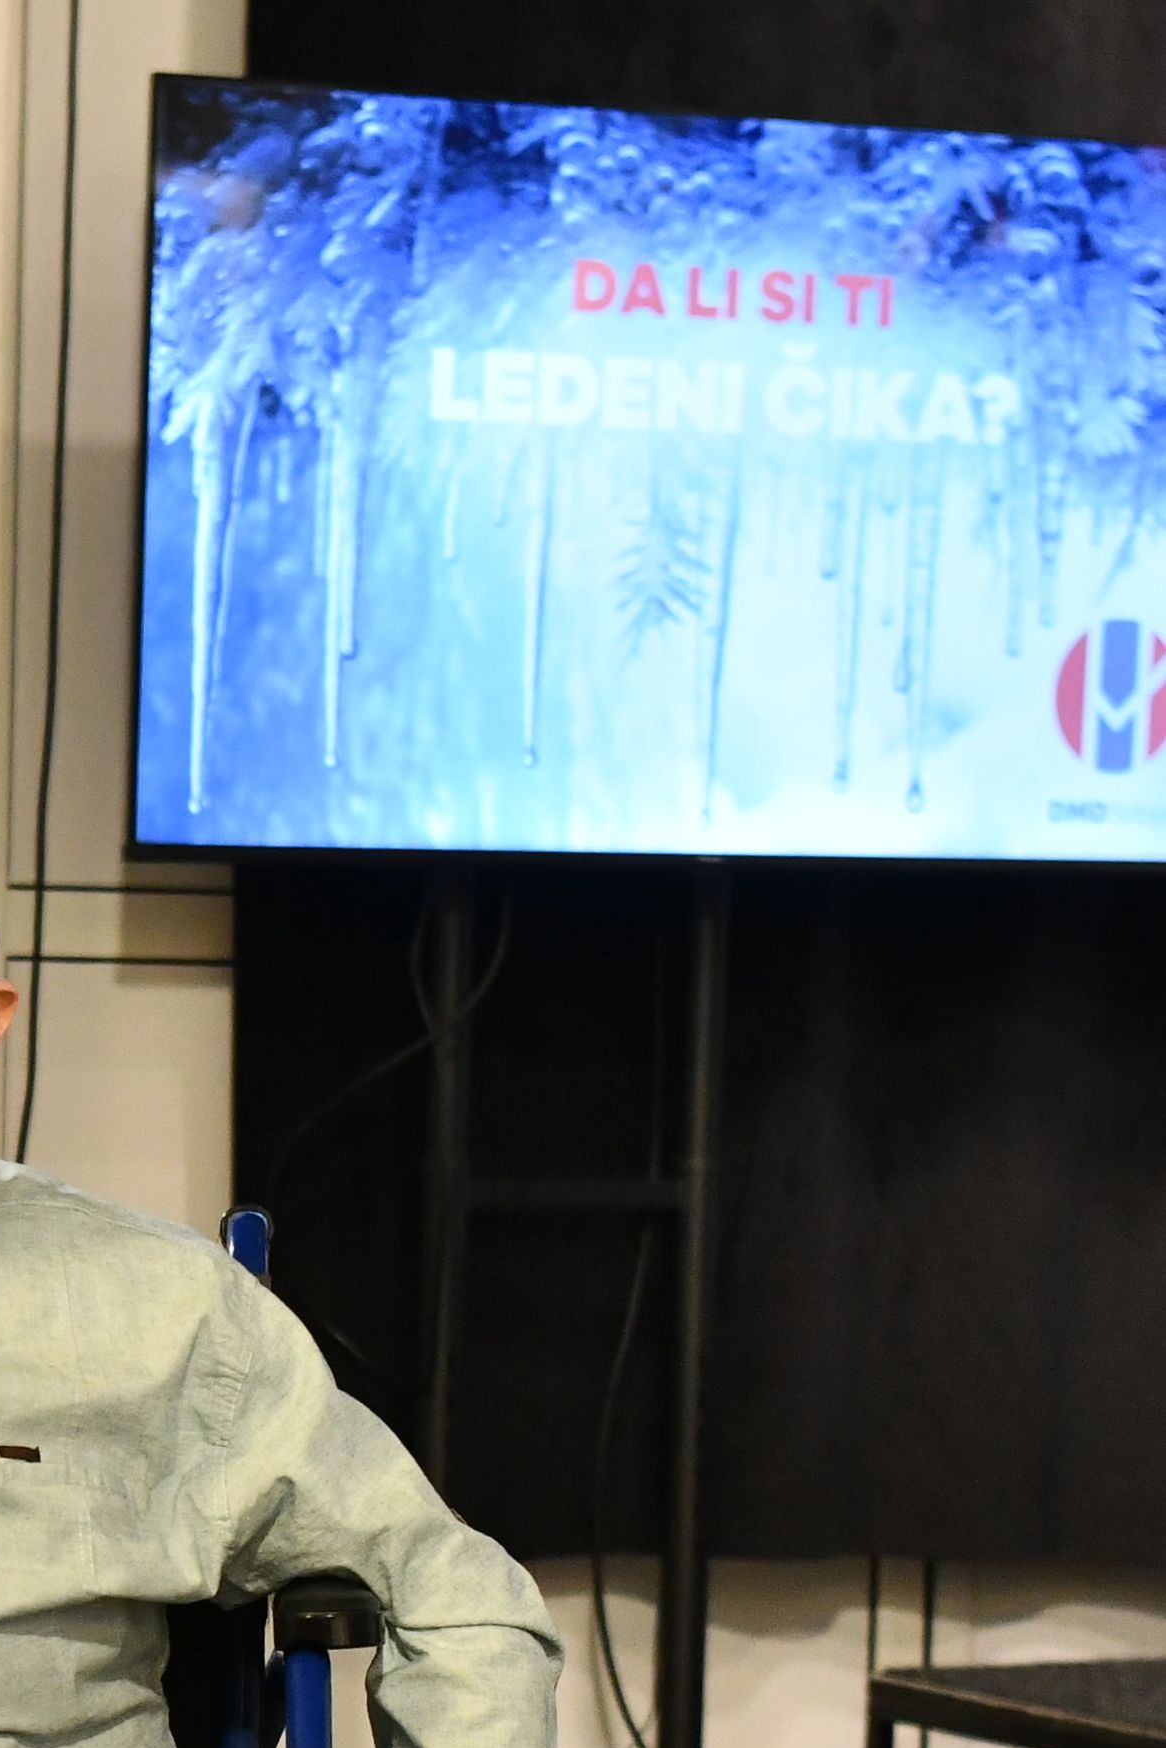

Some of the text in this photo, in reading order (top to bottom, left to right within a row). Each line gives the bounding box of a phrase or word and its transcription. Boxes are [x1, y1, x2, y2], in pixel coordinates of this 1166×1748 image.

[573, 259, 892, 327] DA LI SI TI
[430, 342, 1021, 446] LEDENI ČIKA?
